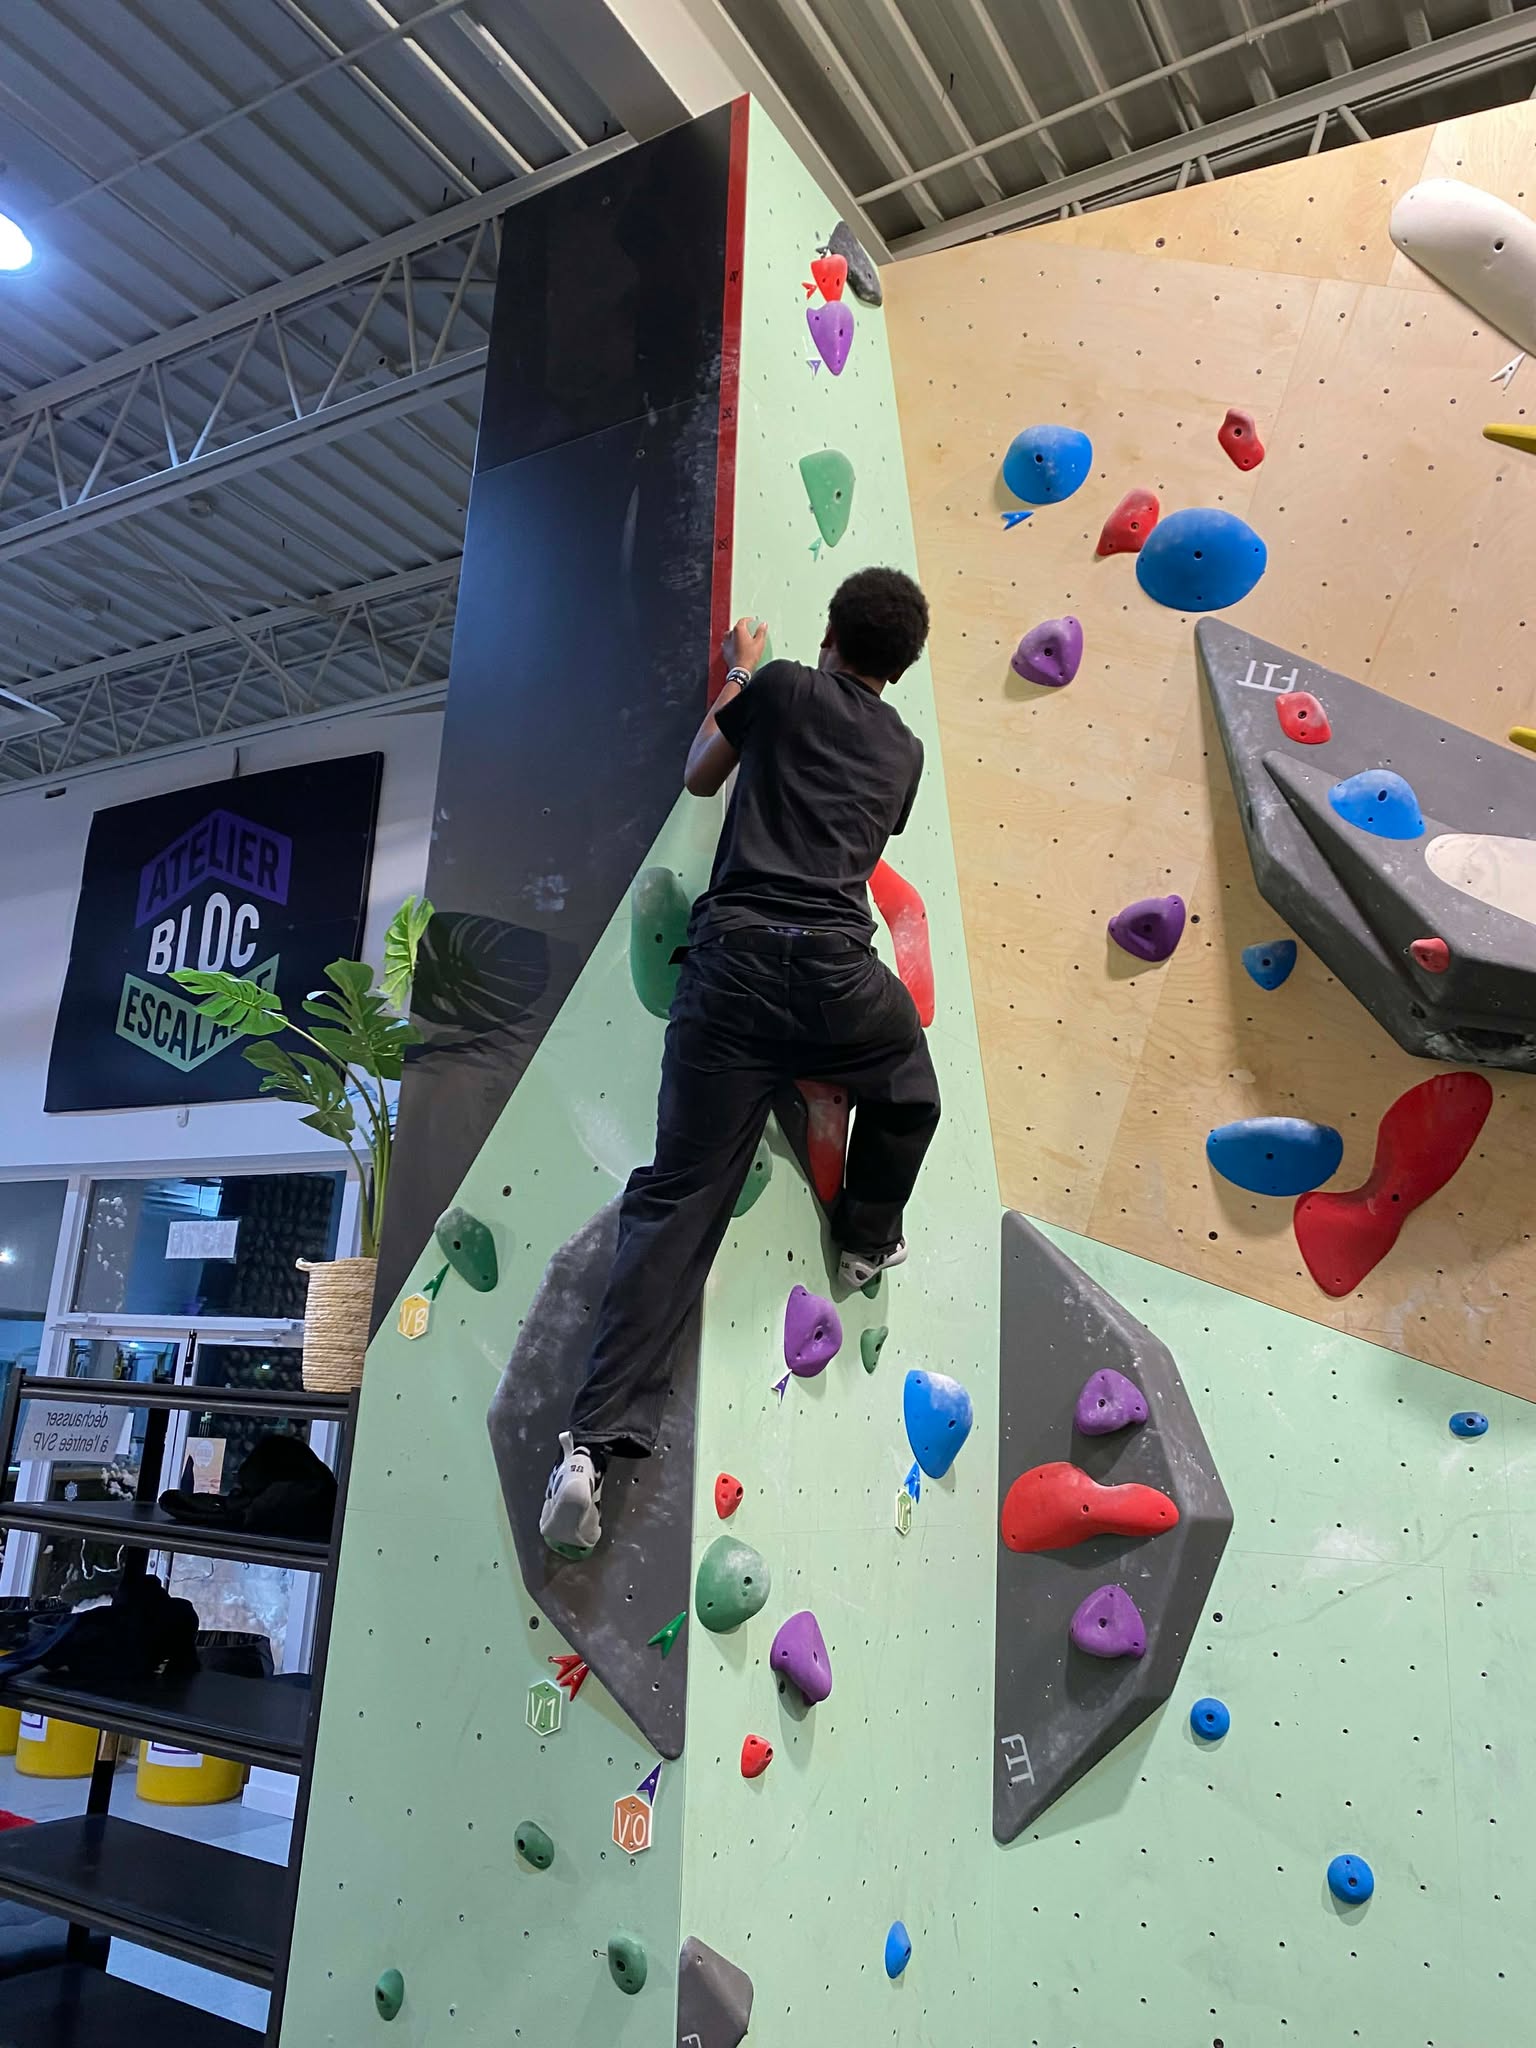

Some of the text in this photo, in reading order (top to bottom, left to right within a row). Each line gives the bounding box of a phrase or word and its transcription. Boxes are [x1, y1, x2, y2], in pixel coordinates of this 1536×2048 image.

[1236, 660, 1299, 694] FIT
[145, 816, 280, 912] ATELIER
[146, 892, 260, 976] BLOC
[123, 968, 272, 1063] ESCALA
[402, 1305, 427, 1333] VB
[531, 1692, 557, 1728] V1
[1001, 1733, 1035, 1786] FIT
